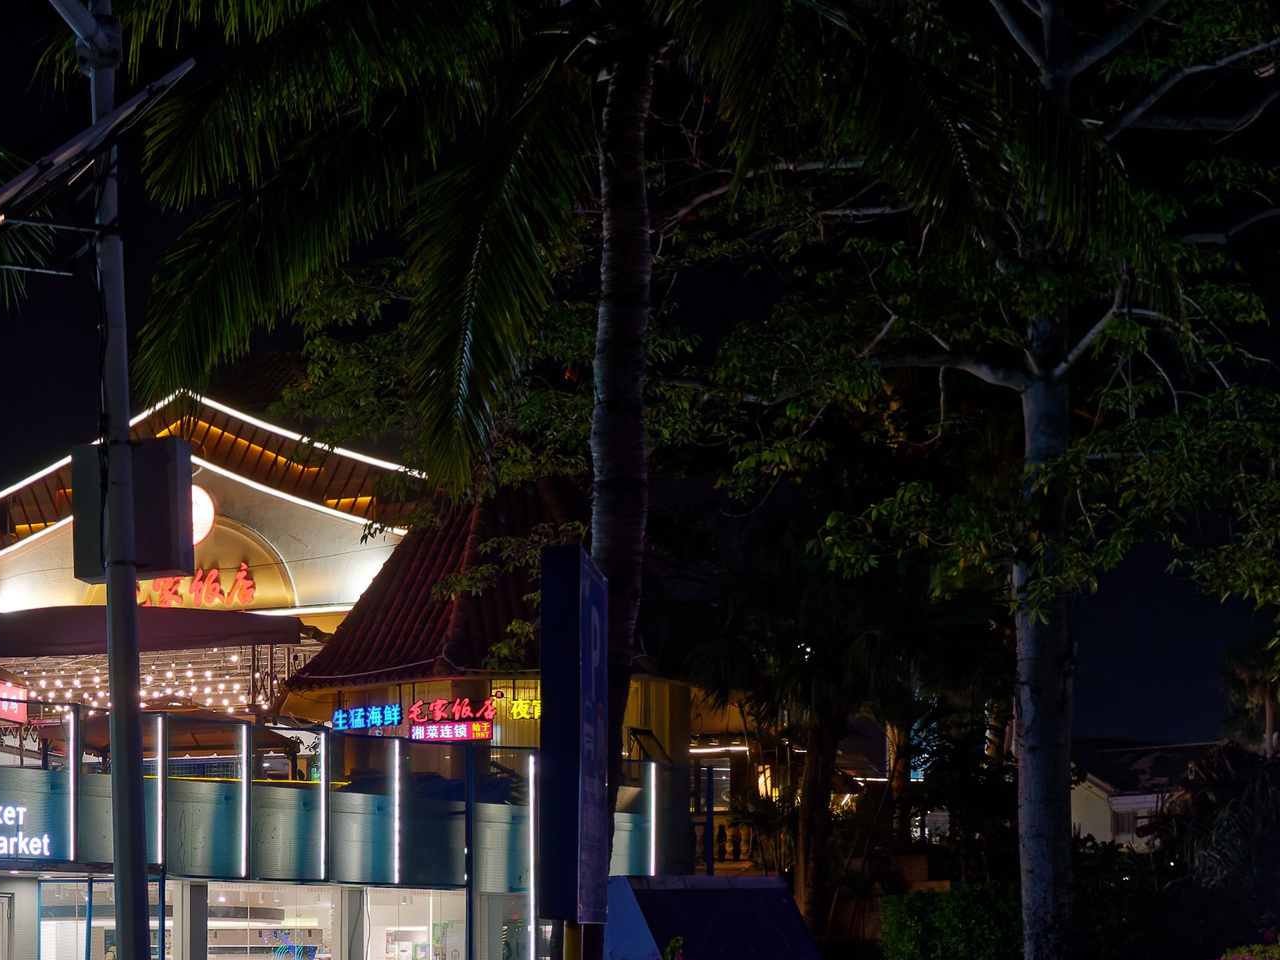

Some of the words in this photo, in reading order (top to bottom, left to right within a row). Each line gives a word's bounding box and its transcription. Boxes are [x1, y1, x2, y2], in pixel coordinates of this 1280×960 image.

[136, 561, 256, 607] 家饭店
[332, 704, 401, 731] 生猛海鲜
[408, 696, 497, 722] 毛家饭店
[411, 724, 468, 740] 湘菜连锁
[472, 731, 490, 739] 1987
